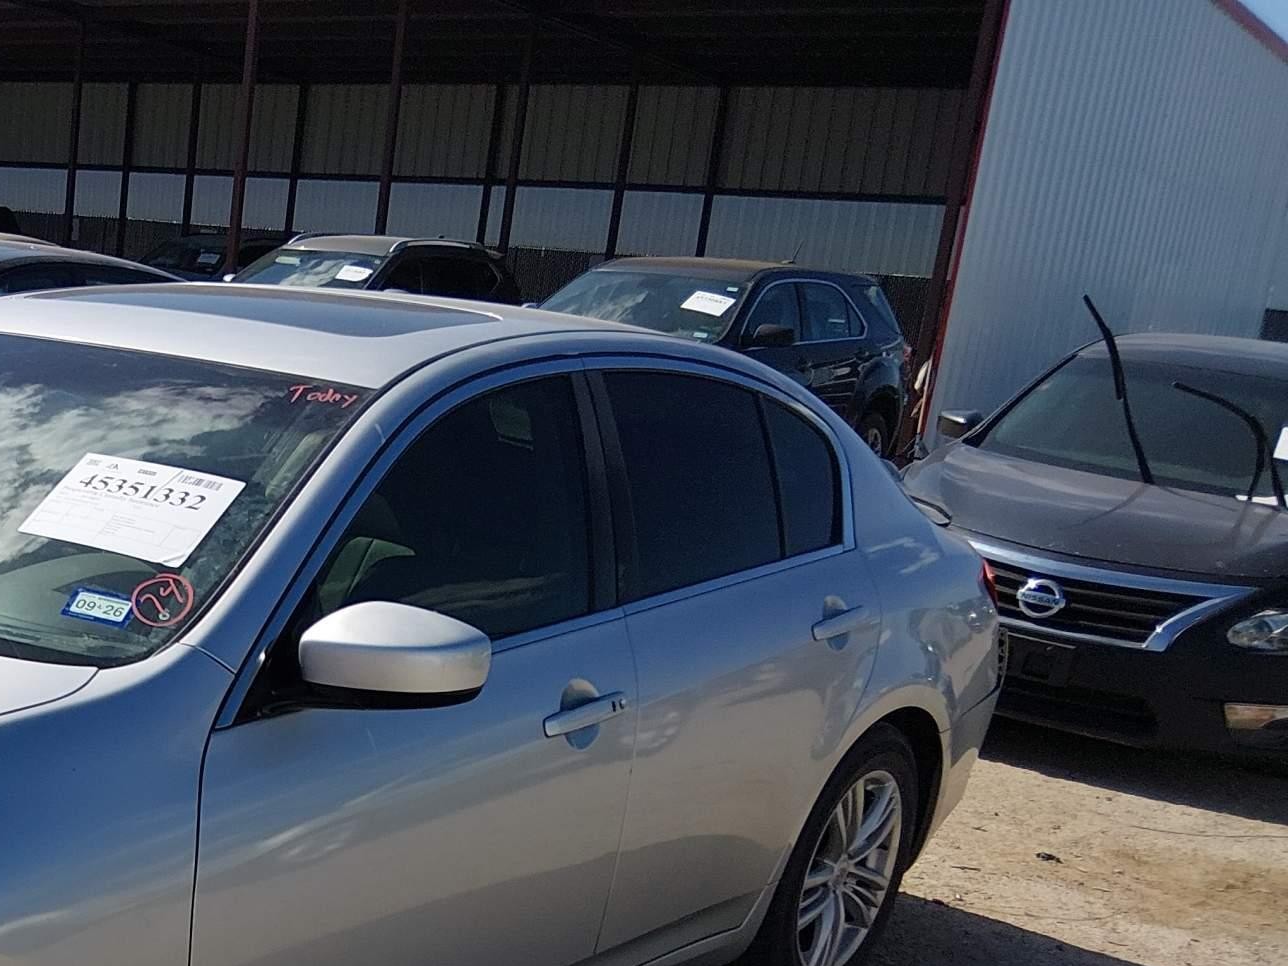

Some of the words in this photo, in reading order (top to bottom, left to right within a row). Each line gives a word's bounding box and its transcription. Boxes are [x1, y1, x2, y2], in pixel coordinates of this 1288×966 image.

[290, 385, 358, 407] Today
[79, 474, 207, 511] 45351332
[75, 599, 97, 611] 09
[102, 604, 125, 617] 26
